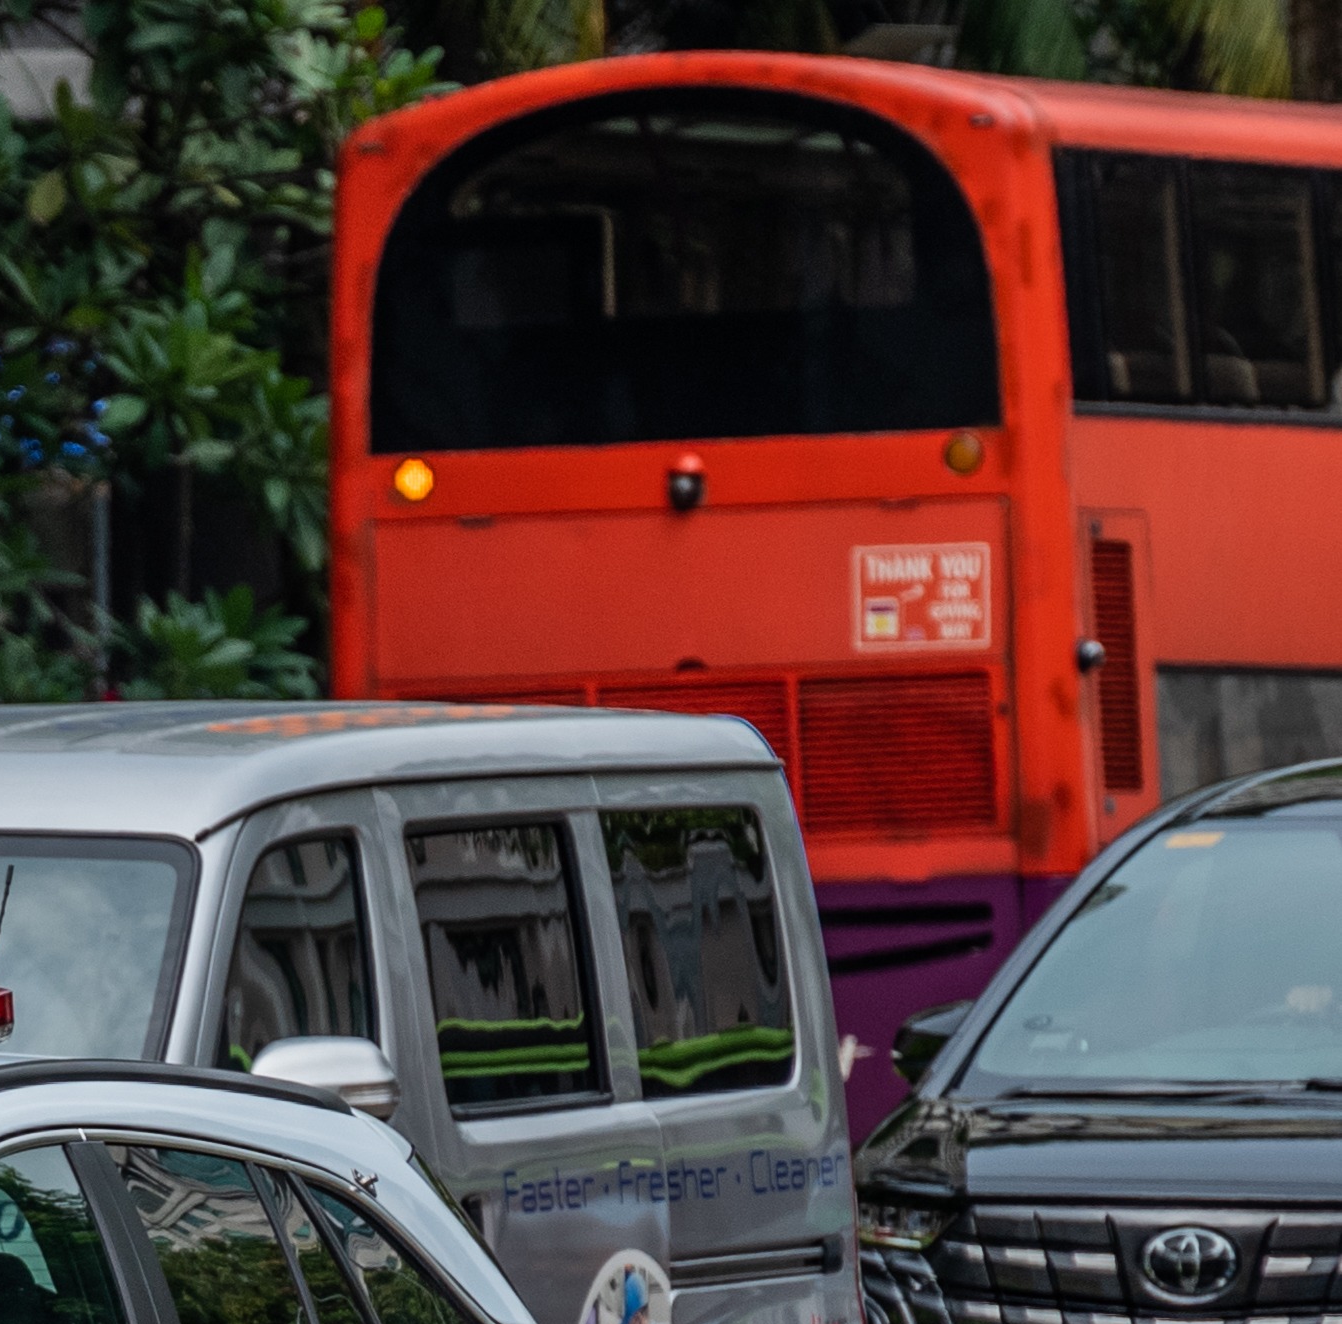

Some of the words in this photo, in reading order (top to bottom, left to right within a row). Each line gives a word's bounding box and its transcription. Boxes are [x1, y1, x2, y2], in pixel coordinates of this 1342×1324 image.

[865, 555, 933, 582] THANK
[939, 554, 982, 580] YOU
[503, 1170, 595, 1213] Faster
[616, 1160, 727, 1203] Fresher
[750, 1150, 846, 1195] Cleaner
